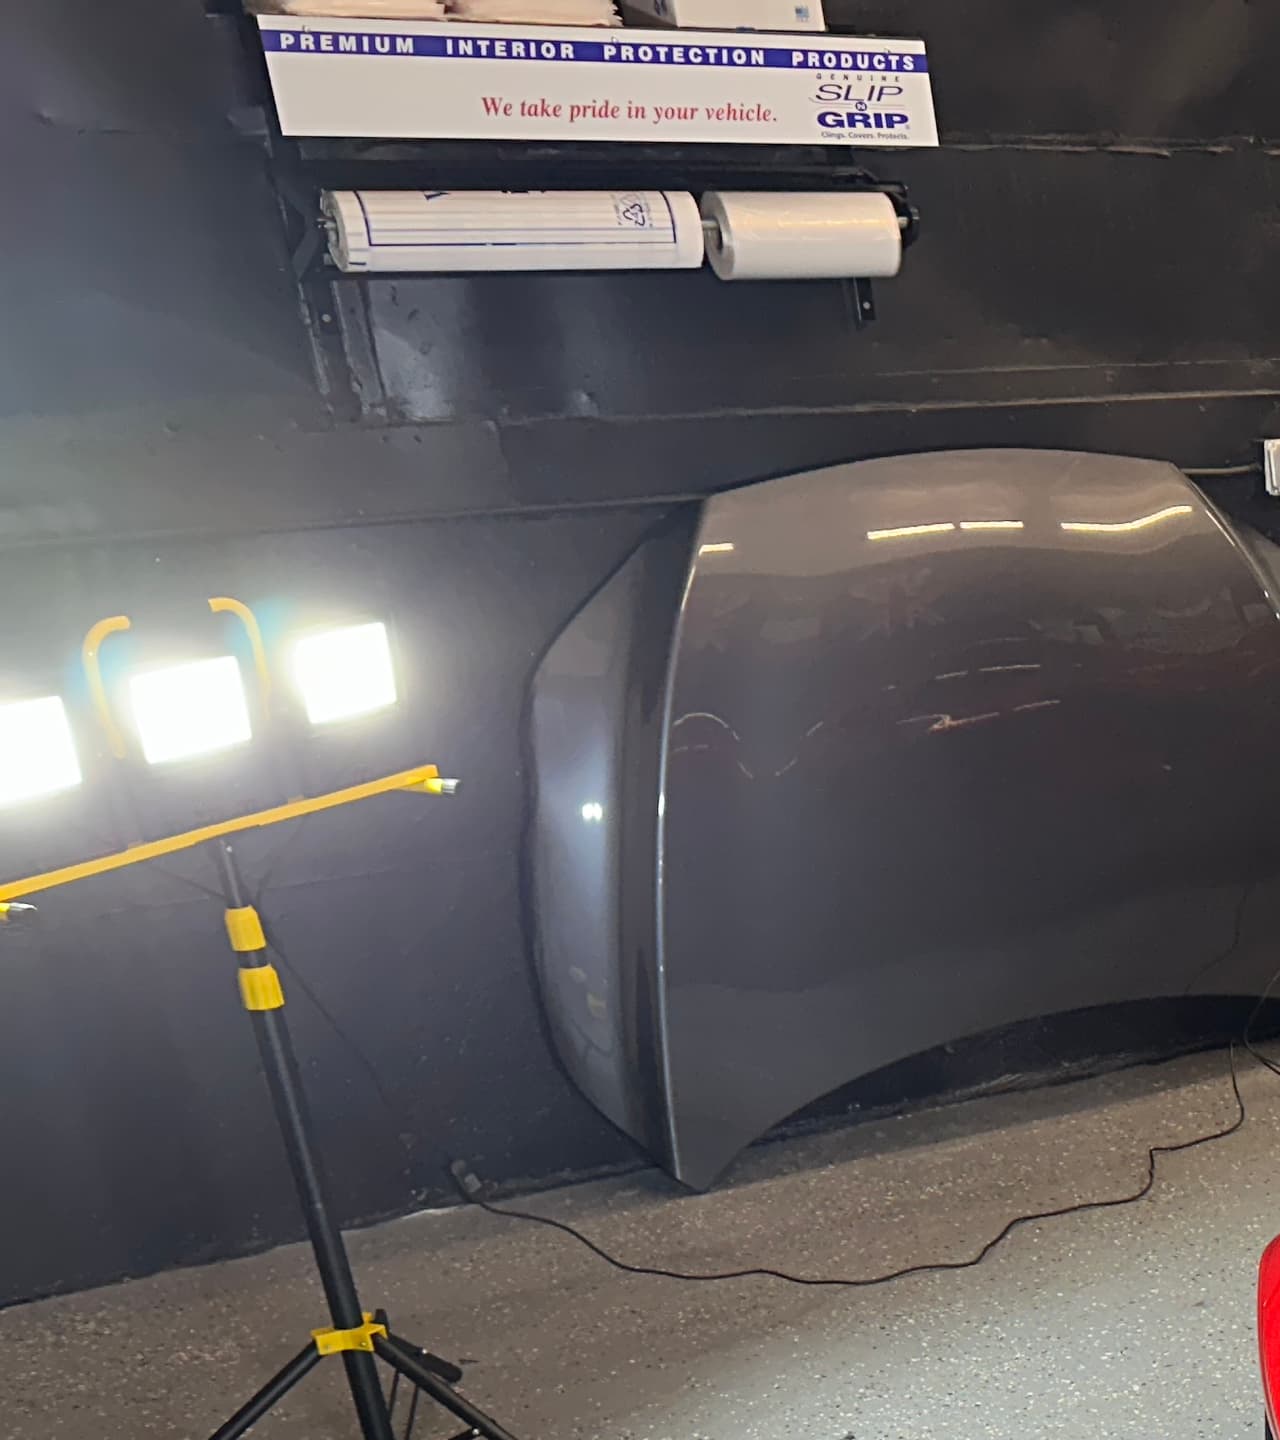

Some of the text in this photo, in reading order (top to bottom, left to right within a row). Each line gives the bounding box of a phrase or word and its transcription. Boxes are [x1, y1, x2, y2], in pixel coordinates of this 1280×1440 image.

[280, 33, 915, 71] PREMIUM INTERIOR PROTECTION PRODUCTS
[816, 73, 900, 82] GENUINE
[815, 84, 903, 101] SLIP
[482, 97, 778, 124] We take pride in your vehicle.
[817, 111, 908, 128] GRIP
